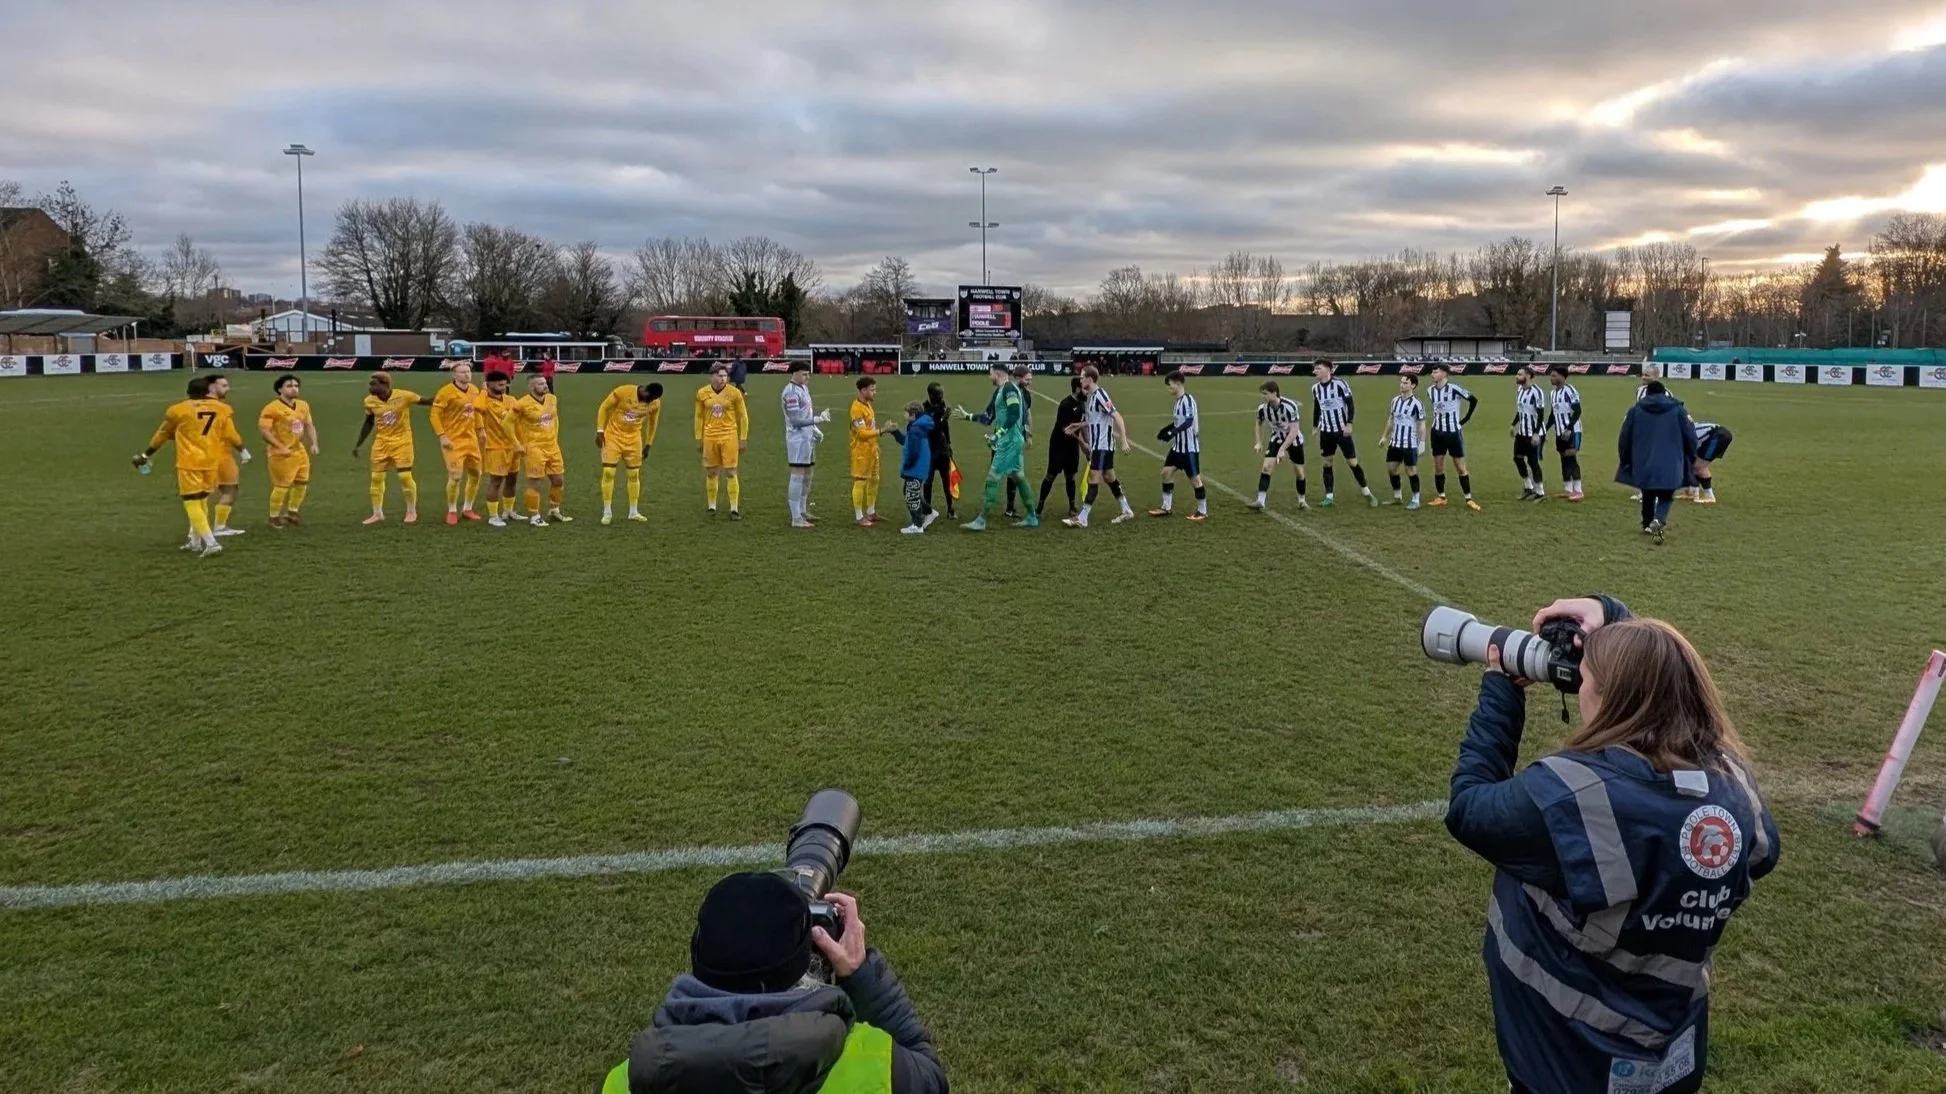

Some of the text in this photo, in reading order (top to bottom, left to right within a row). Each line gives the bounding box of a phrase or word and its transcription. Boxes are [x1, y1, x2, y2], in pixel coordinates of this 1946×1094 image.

[204, 354, 230, 367] vgc
[929, 363, 966, 371] HANWELL
[966, 363, 989, 371] TOWN
[1027, 363, 1046, 371] CLUB
[197, 411, 217, 437] 7
[1681, 806, 1738, 840] POOLE TOWN
[1681, 836, 1741, 878] FOOTBALL CLUB
[1679, 884, 1731, 909] Club
[1641, 906, 1731, 931] Volune
